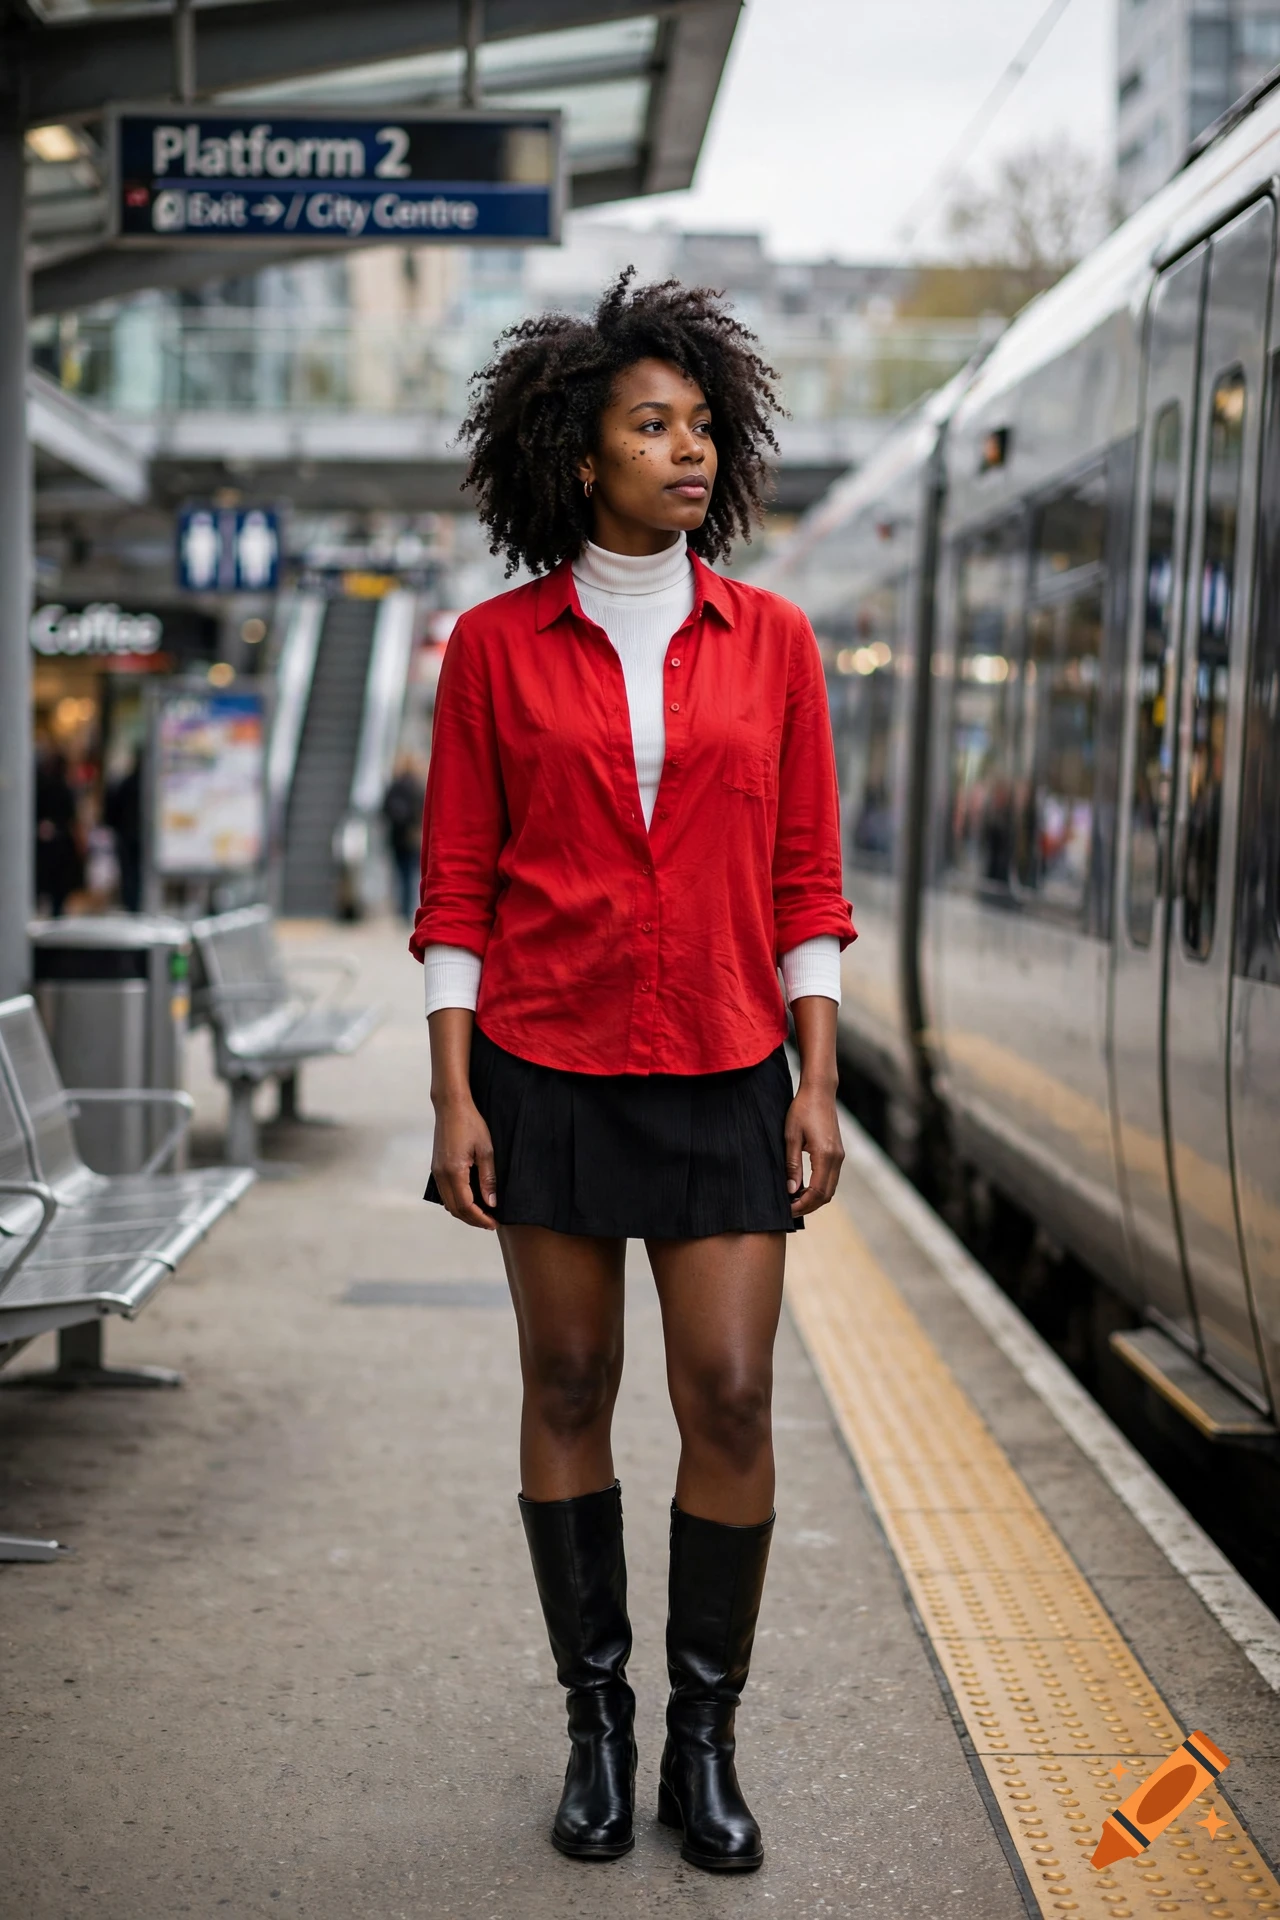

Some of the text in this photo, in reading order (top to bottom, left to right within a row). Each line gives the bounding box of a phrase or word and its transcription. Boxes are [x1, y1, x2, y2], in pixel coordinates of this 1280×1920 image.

[153, 126, 412, 179] Platform 2
[187, 194, 249, 228] Exit
[373, 194, 478, 229] Centre
[30, 604, 162, 655] Coffee
